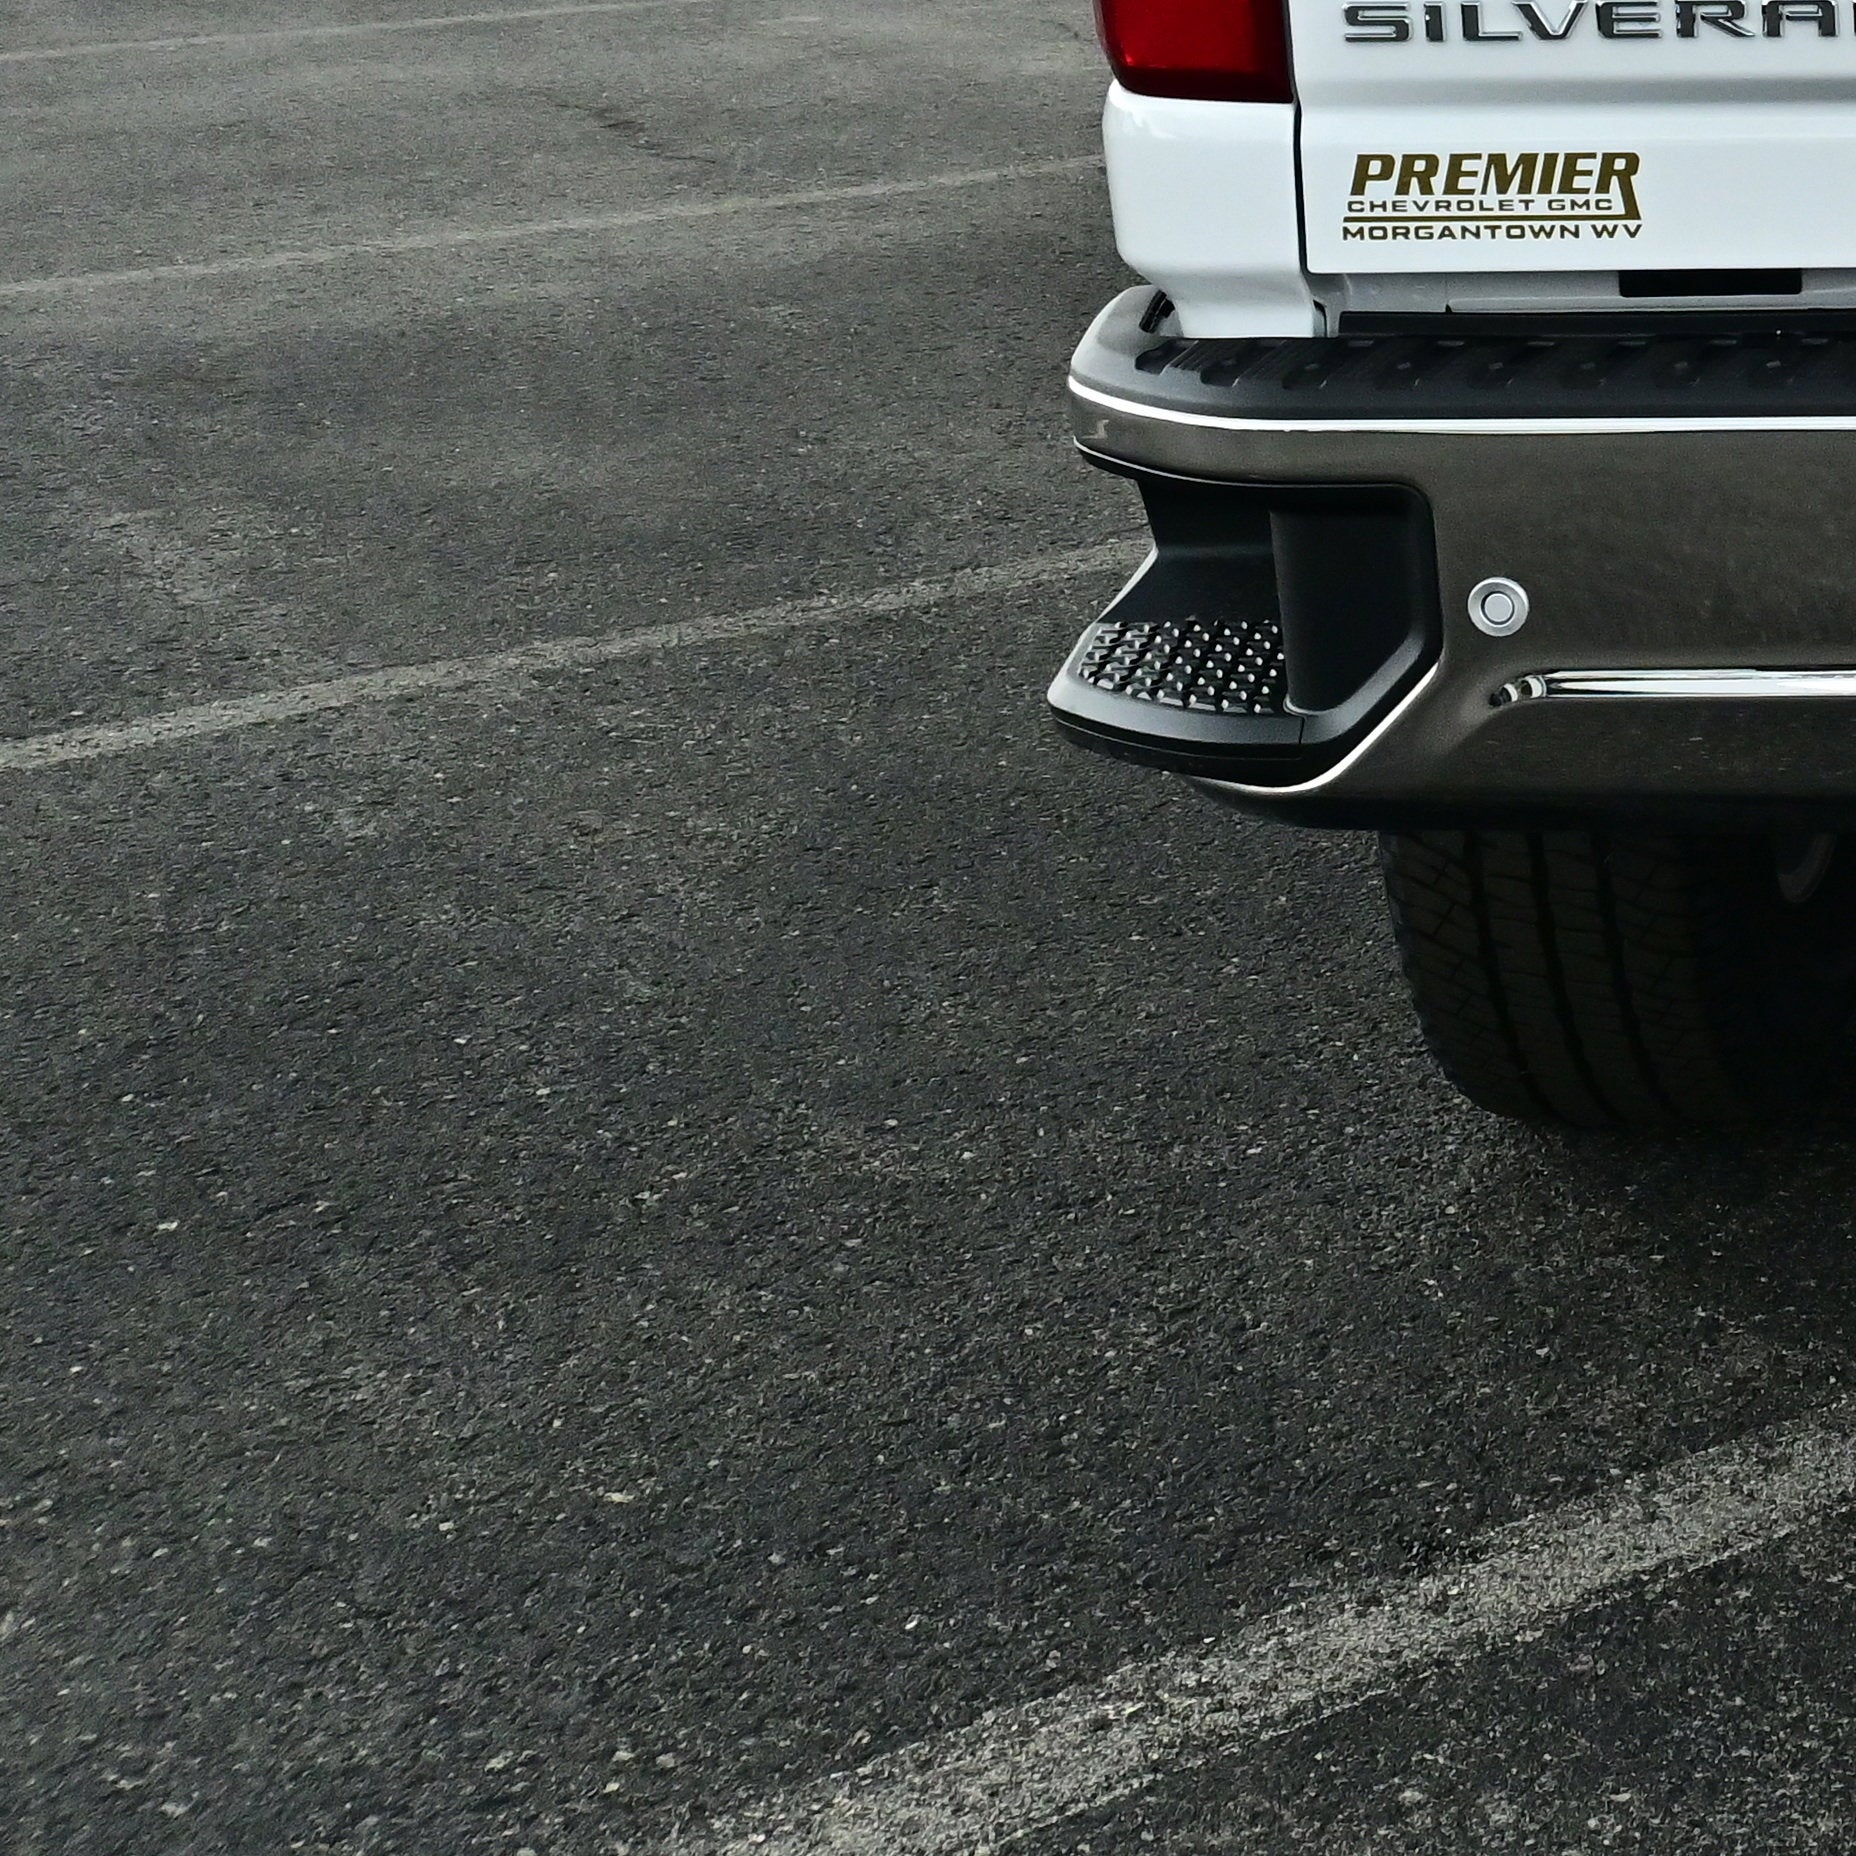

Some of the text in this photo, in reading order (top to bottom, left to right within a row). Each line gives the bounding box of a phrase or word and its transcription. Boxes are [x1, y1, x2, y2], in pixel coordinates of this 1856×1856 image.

[1348, 151, 1642, 206] PREMIER
[1346, 197, 1613, 213] CHEVROLET GMC
[1342, 223, 1643, 241] MORGANTOWN WV
